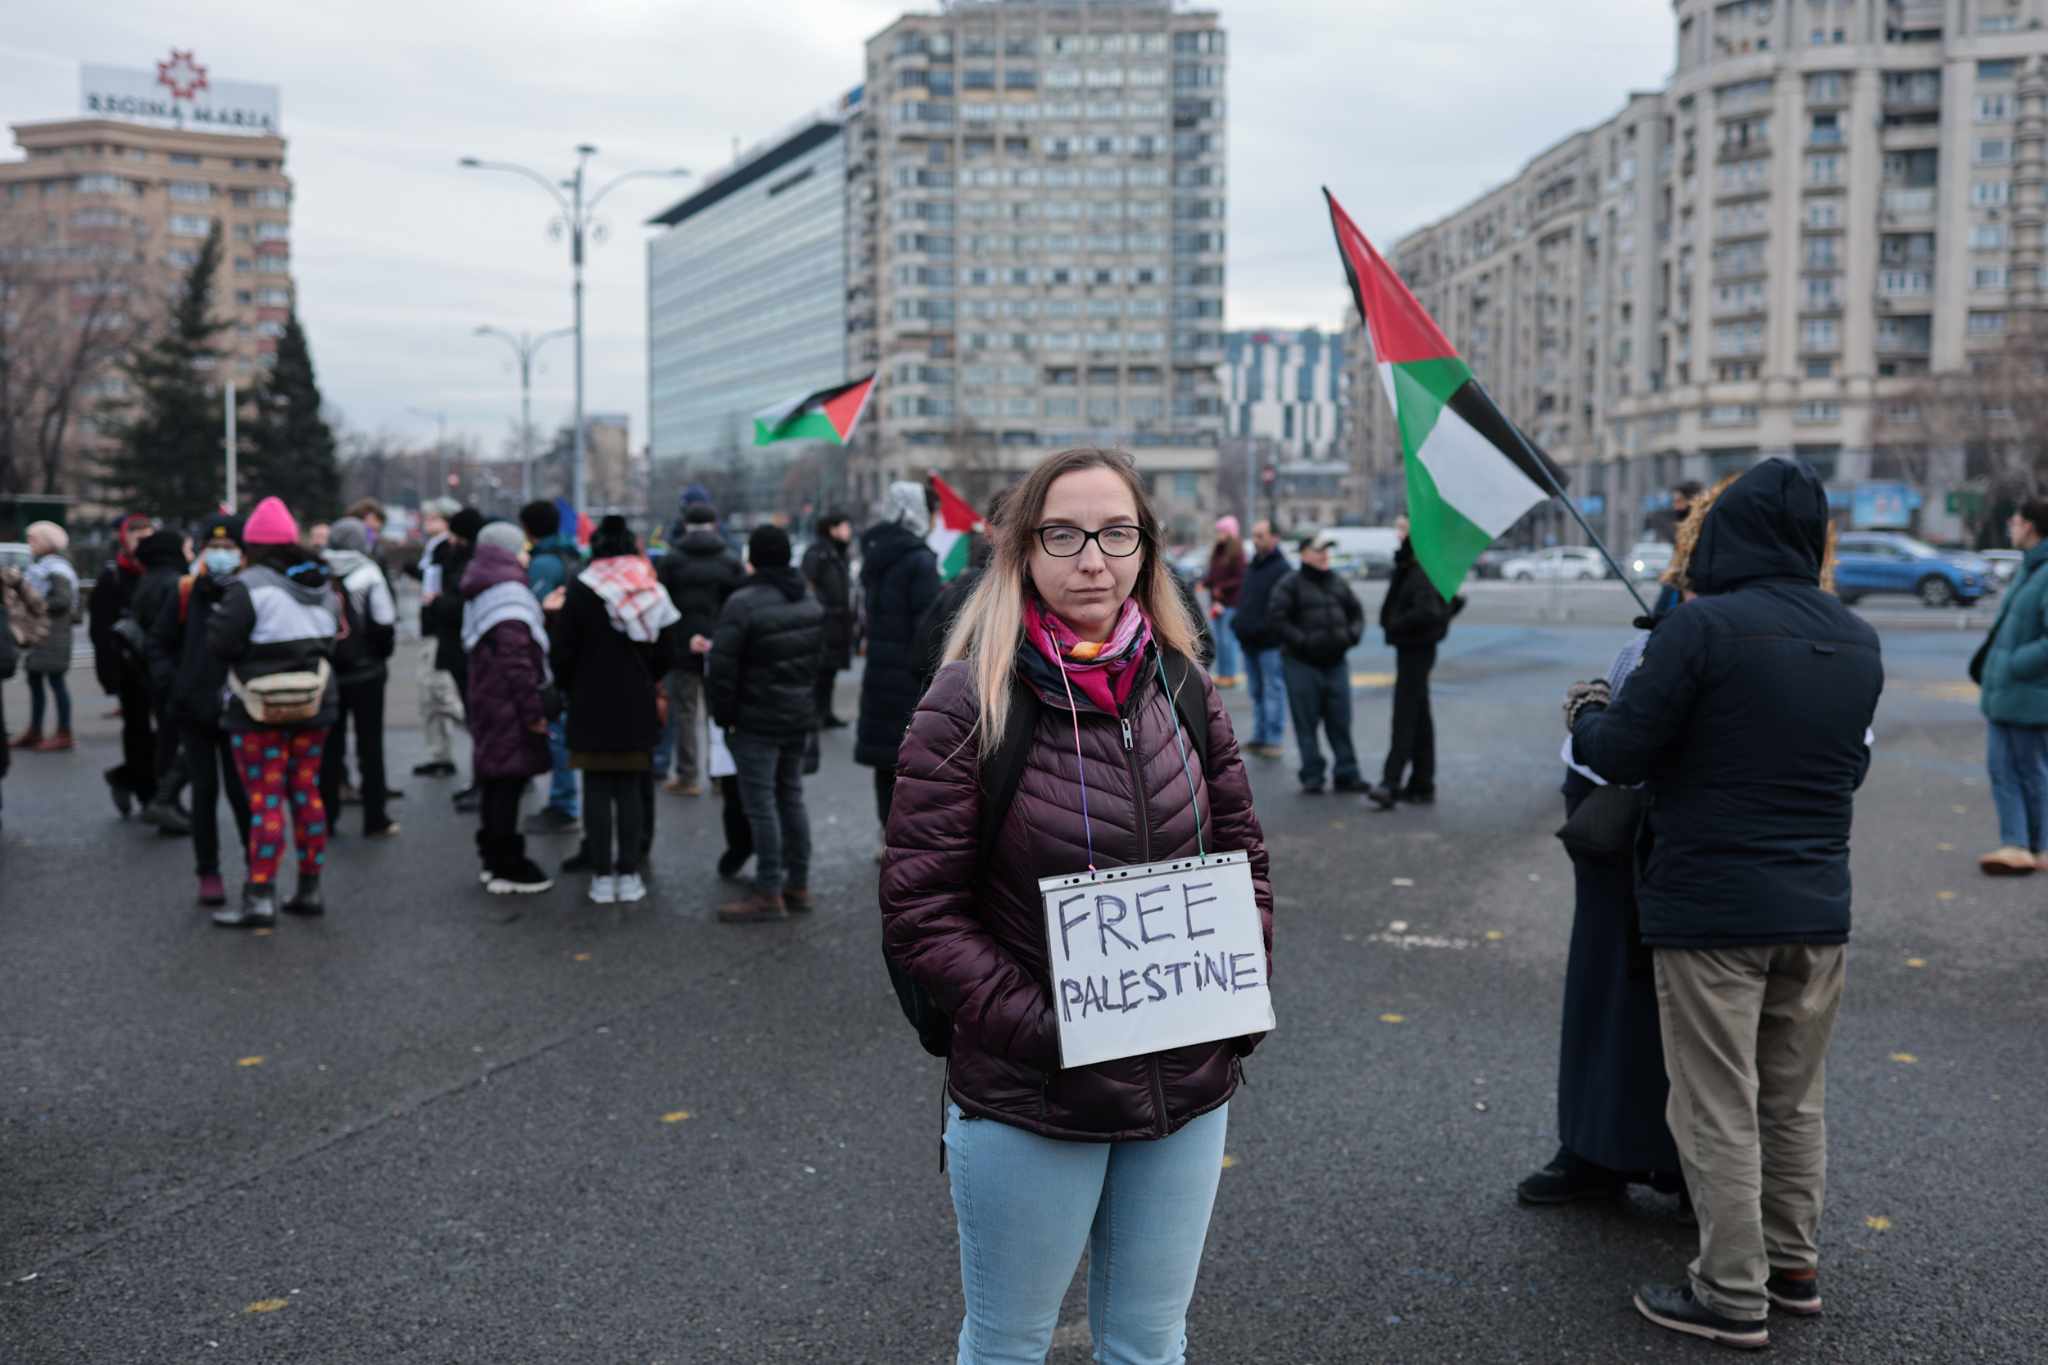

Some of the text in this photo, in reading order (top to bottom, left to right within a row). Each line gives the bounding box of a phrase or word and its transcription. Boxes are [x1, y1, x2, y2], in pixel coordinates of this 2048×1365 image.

[87, 92, 271, 127] REGINA MARIA
[1058, 882, 1218, 961] FREE
